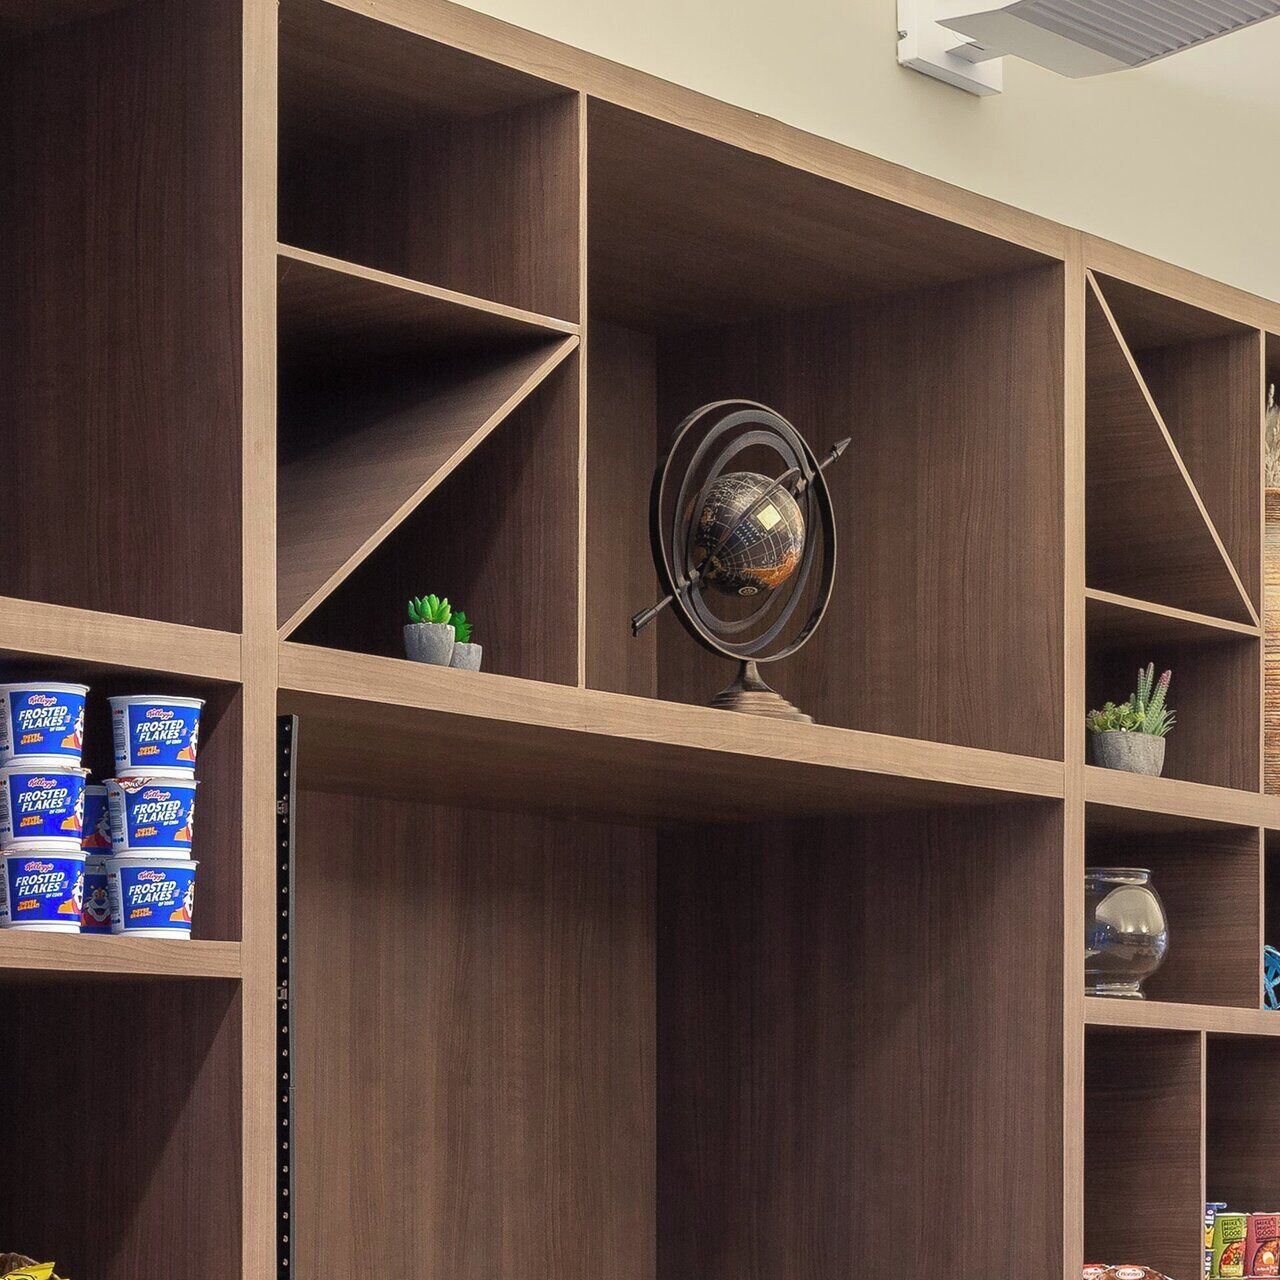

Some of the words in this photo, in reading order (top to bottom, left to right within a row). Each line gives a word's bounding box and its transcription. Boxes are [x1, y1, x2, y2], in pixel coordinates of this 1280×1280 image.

[19, 706, 68, 721] FROSTED
[22, 717, 63, 730] FLAKES
[136, 719, 184, 734] FROSTED
[139, 729, 180, 742] FLAKES
[18, 788, 68, 804] FROSTED
[21, 798, 64, 812] FLAKES
[133, 800, 181, 815] FROSTED
[136, 810, 177, 824] FLAKES
[15, 871, 65, 887] FROSTED
[18, 881, 61, 896] FLAKES
[128, 881, 177, 896] FROSTED
[131, 890, 172, 905] FLAKES
